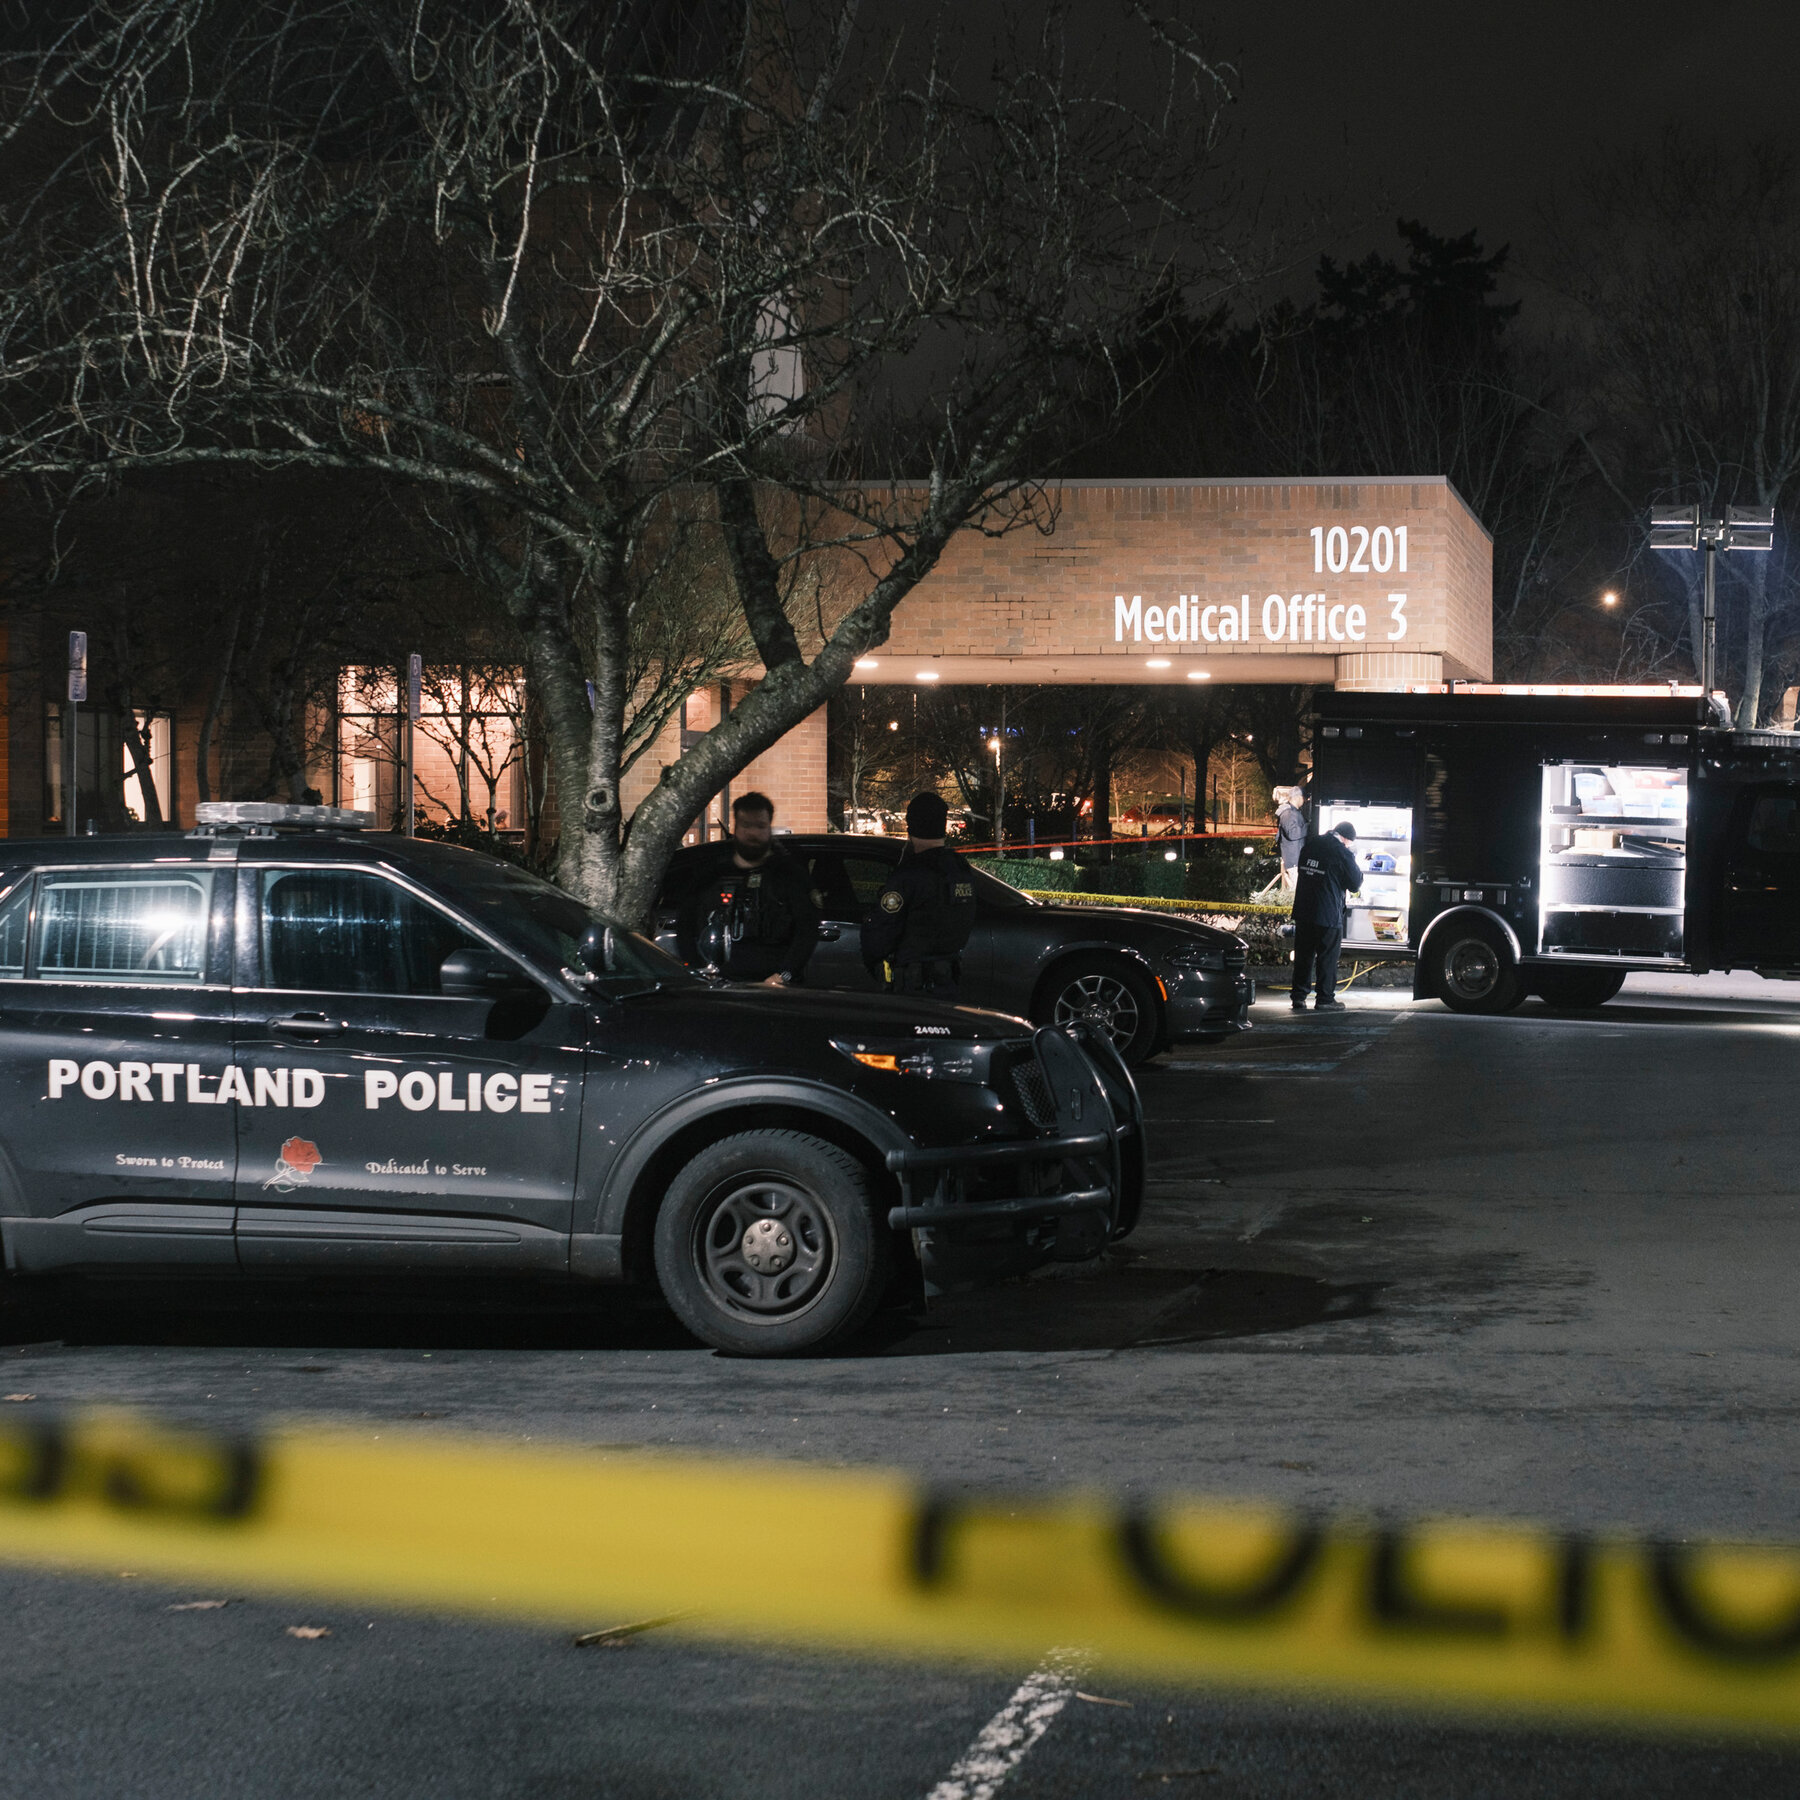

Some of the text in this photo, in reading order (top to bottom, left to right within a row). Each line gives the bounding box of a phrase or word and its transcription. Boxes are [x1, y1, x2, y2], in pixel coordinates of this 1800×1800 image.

[1310, 525, 1408, 573] 10201
[1114, 593, 1408, 642] Medical Office 3
[1307, 859, 1319, 868] FBI
[914, 1026, 951, 1035] 240031
[48, 1059, 552, 1113] PORTLAND POLICE
[115, 1153, 225, 1170] Sworn to Protect
[365, 1158, 487, 1176] Dedicated to Serve
